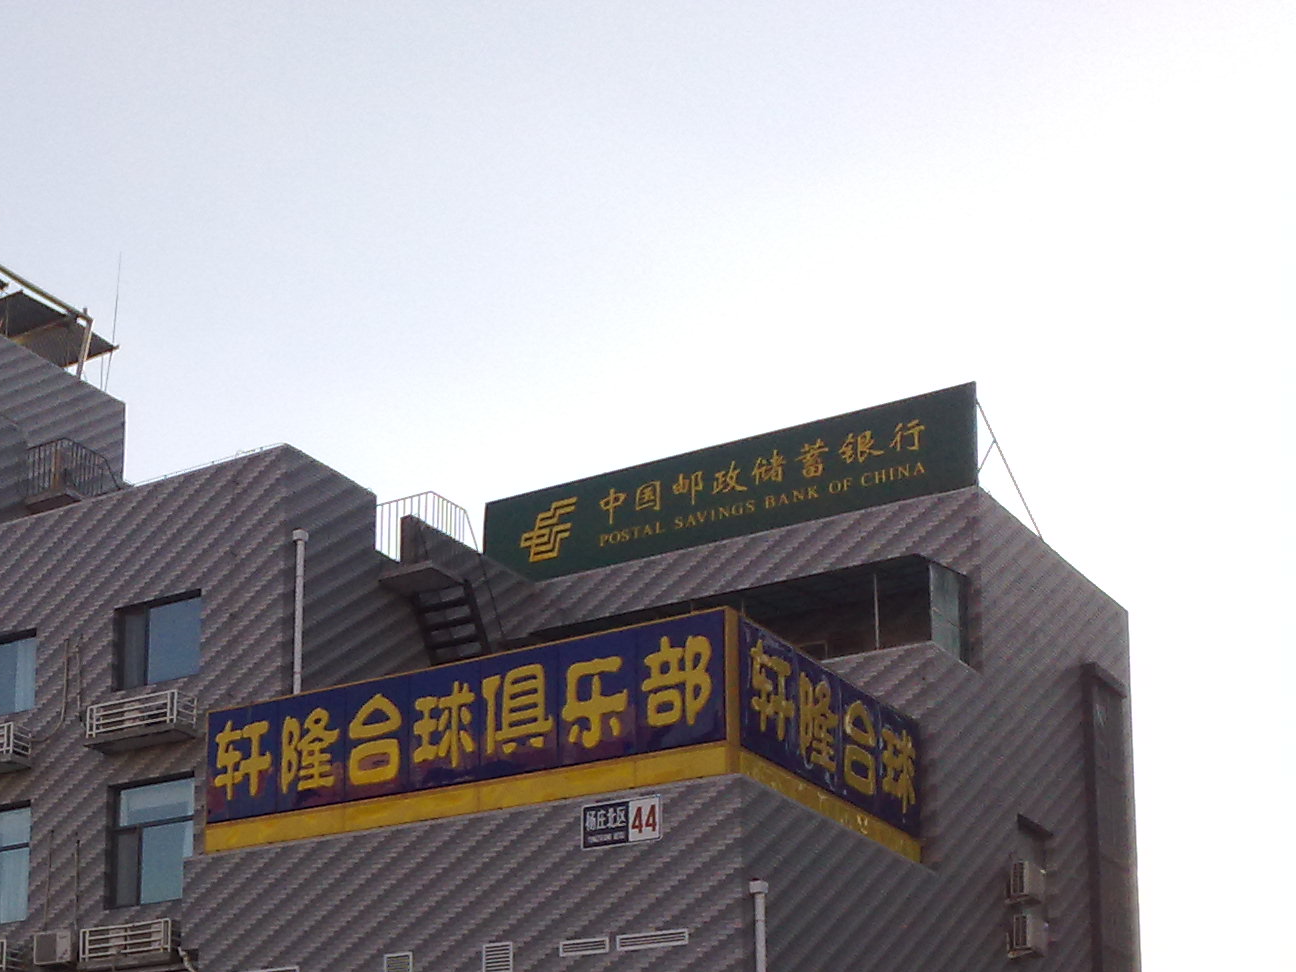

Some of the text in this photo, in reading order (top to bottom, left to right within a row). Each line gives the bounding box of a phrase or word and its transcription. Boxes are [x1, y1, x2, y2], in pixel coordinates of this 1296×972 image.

[598, 419, 926, 525] 中国邮政储蓄银行
[599, 462, 926, 547] POSTAL SAVINGS BANK OF CHINA
[213, 634, 713, 800] 轩隆台球俱乐部
[631, 804, 657, 834] 44
